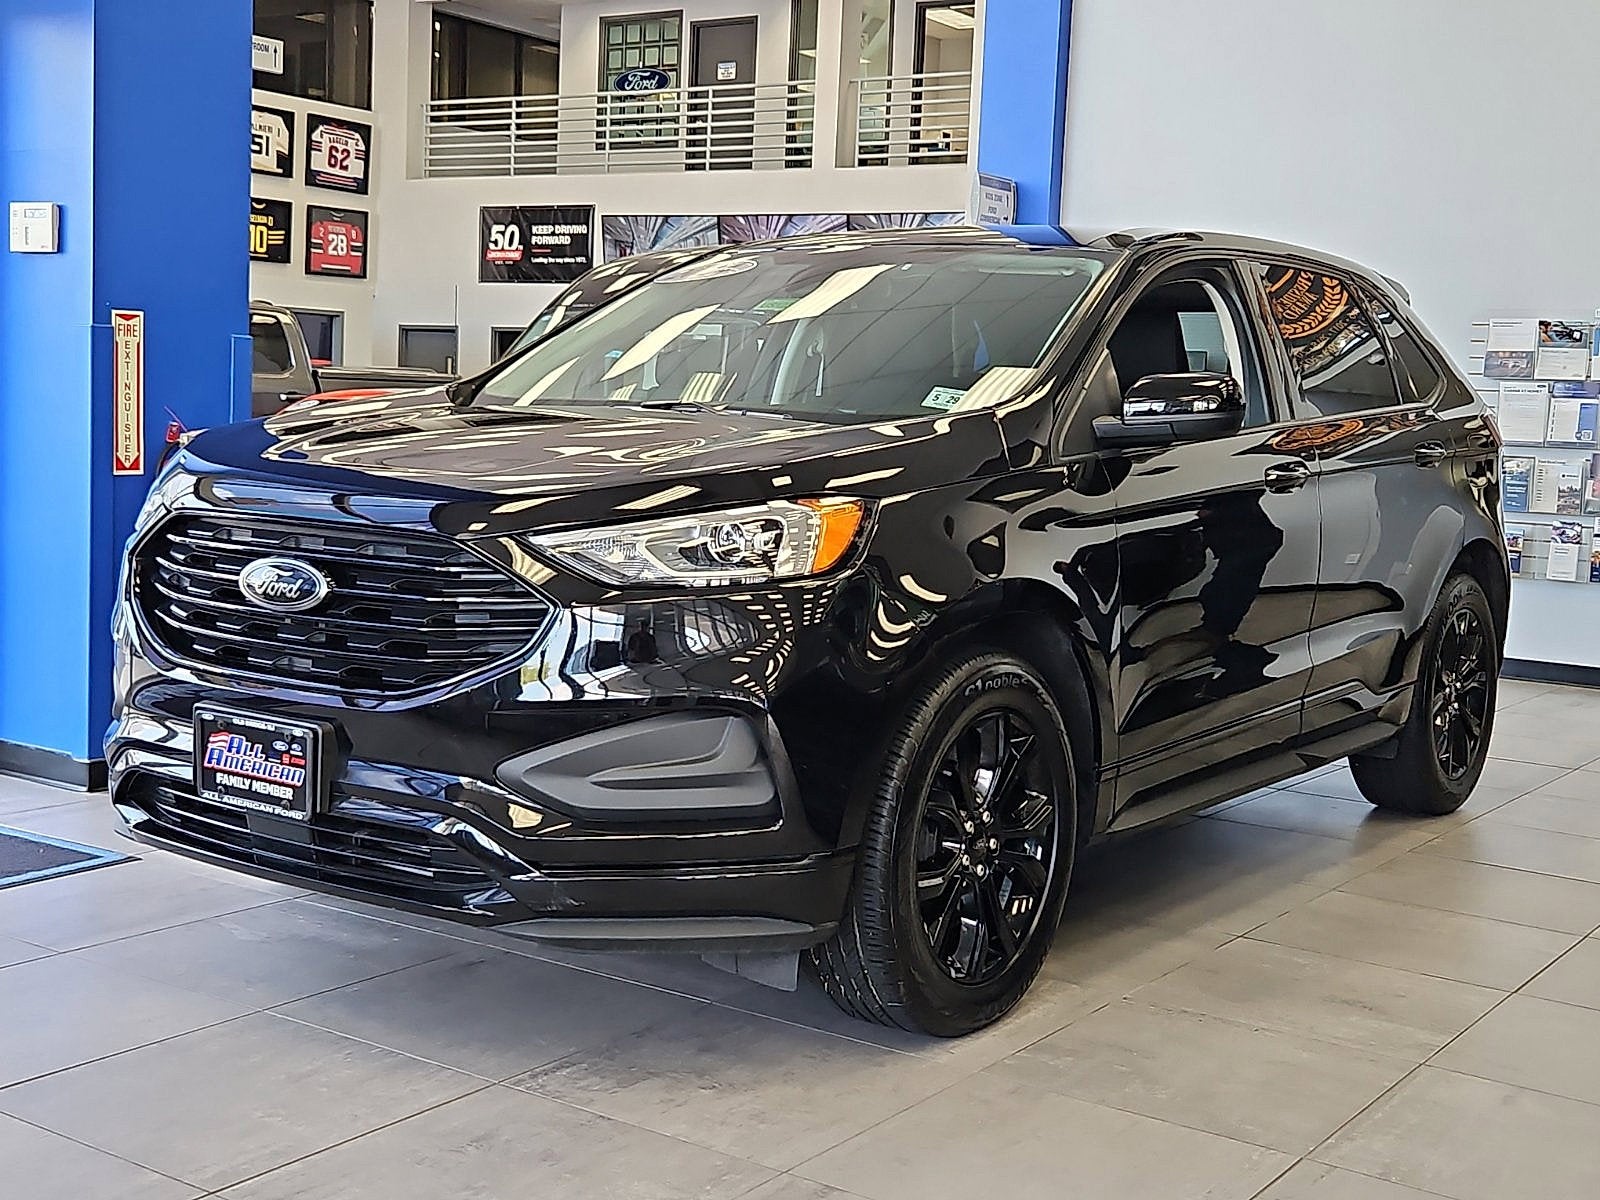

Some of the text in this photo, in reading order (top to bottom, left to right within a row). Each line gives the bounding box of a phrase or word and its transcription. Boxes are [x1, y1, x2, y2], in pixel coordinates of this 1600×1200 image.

[624, 71, 660, 91] Ford
[251, 133, 270, 157] 51
[327, 144, 351, 172] 62
[250, 224, 268, 253] 10
[488, 224, 520, 251] 50
[531, 224, 588, 234] KEEP DRIVING
[531, 235, 572, 245] FORWARD
[327, 233, 347, 256] 28
[117, 323, 138, 338] FIRE
[254, 564, 304, 599] Ford
[215, 772, 294, 801] FAMILY MEMBER
[202, 792, 303, 820] ALL AMERICAN FORD
